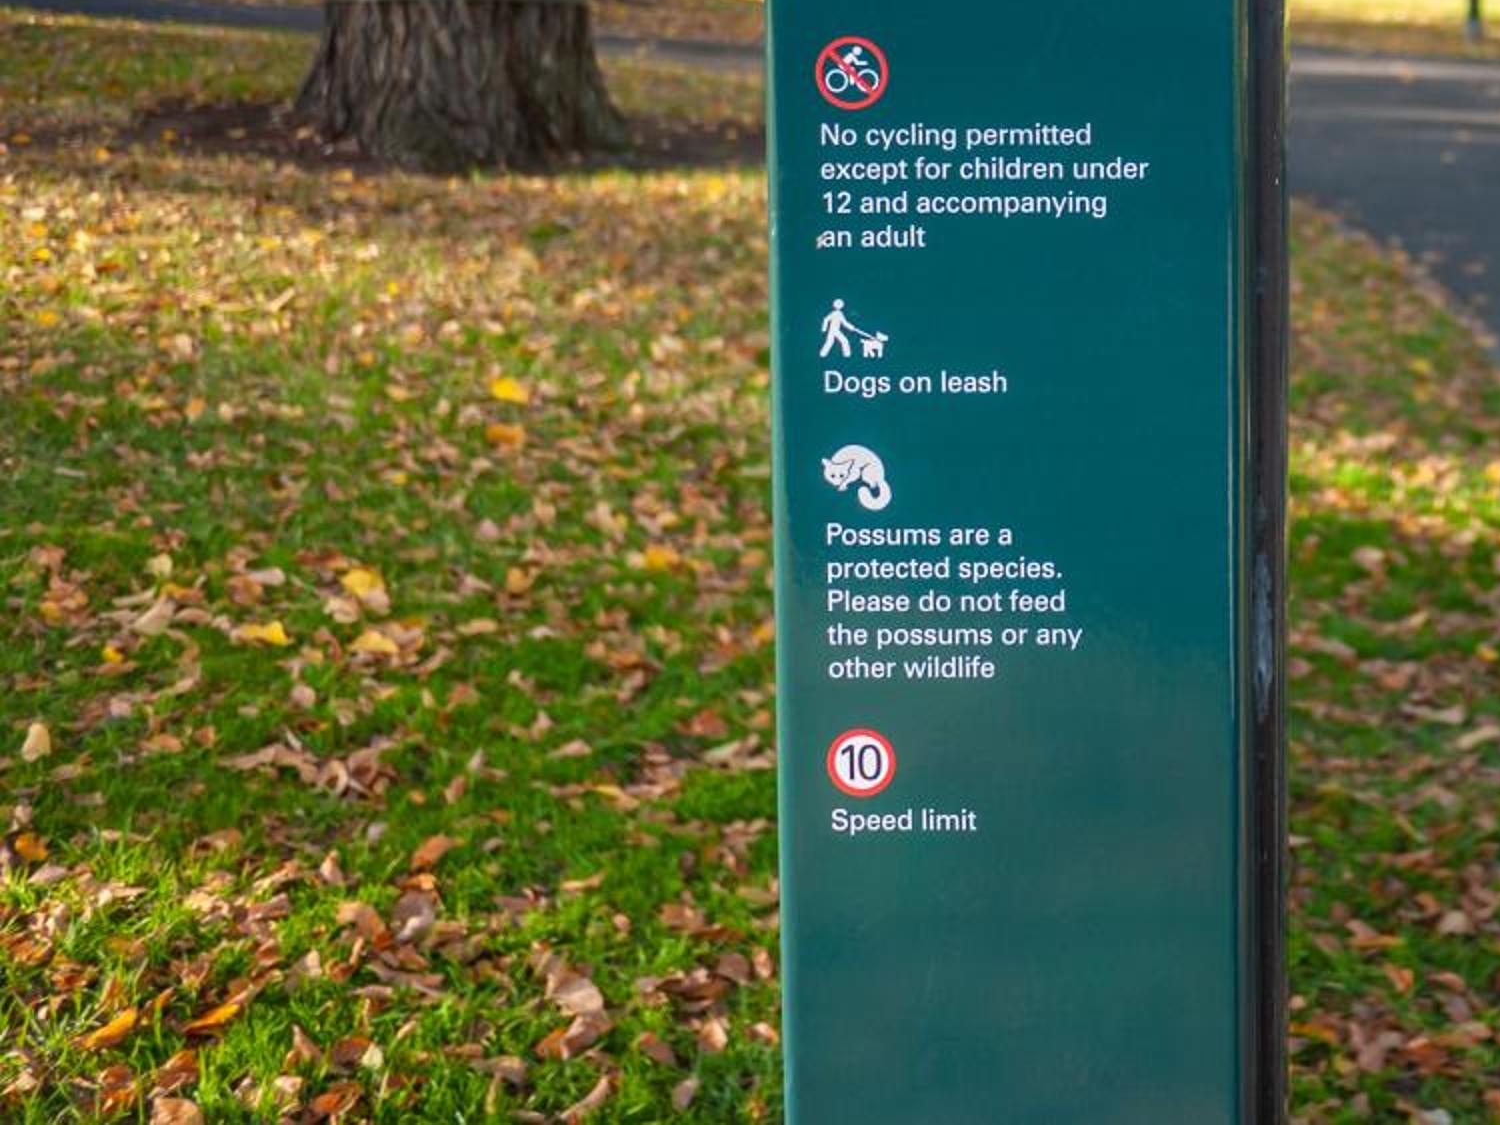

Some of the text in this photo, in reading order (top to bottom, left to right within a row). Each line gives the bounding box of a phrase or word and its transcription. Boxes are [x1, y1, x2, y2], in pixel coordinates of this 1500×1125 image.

[820, 122, 1092, 150] No cycling permitted
[820, 157, 1150, 184] except for children under
[823, 191, 1107, 218] 12 and accompanying
[820, 226, 926, 248] an adult
[824, 371, 1008, 398] Dogs on leash
[826, 523, 1013, 546] Possums are a
[826, 557, 1063, 583] protected species.
[827, 590, 1066, 613] Please do not feed
[827, 624, 1083, 651] the possums or any
[828, 657, 996, 680] other wildlife
[841, 744, 884, 781] 10
[831, 809, 977, 836] Speed limit
